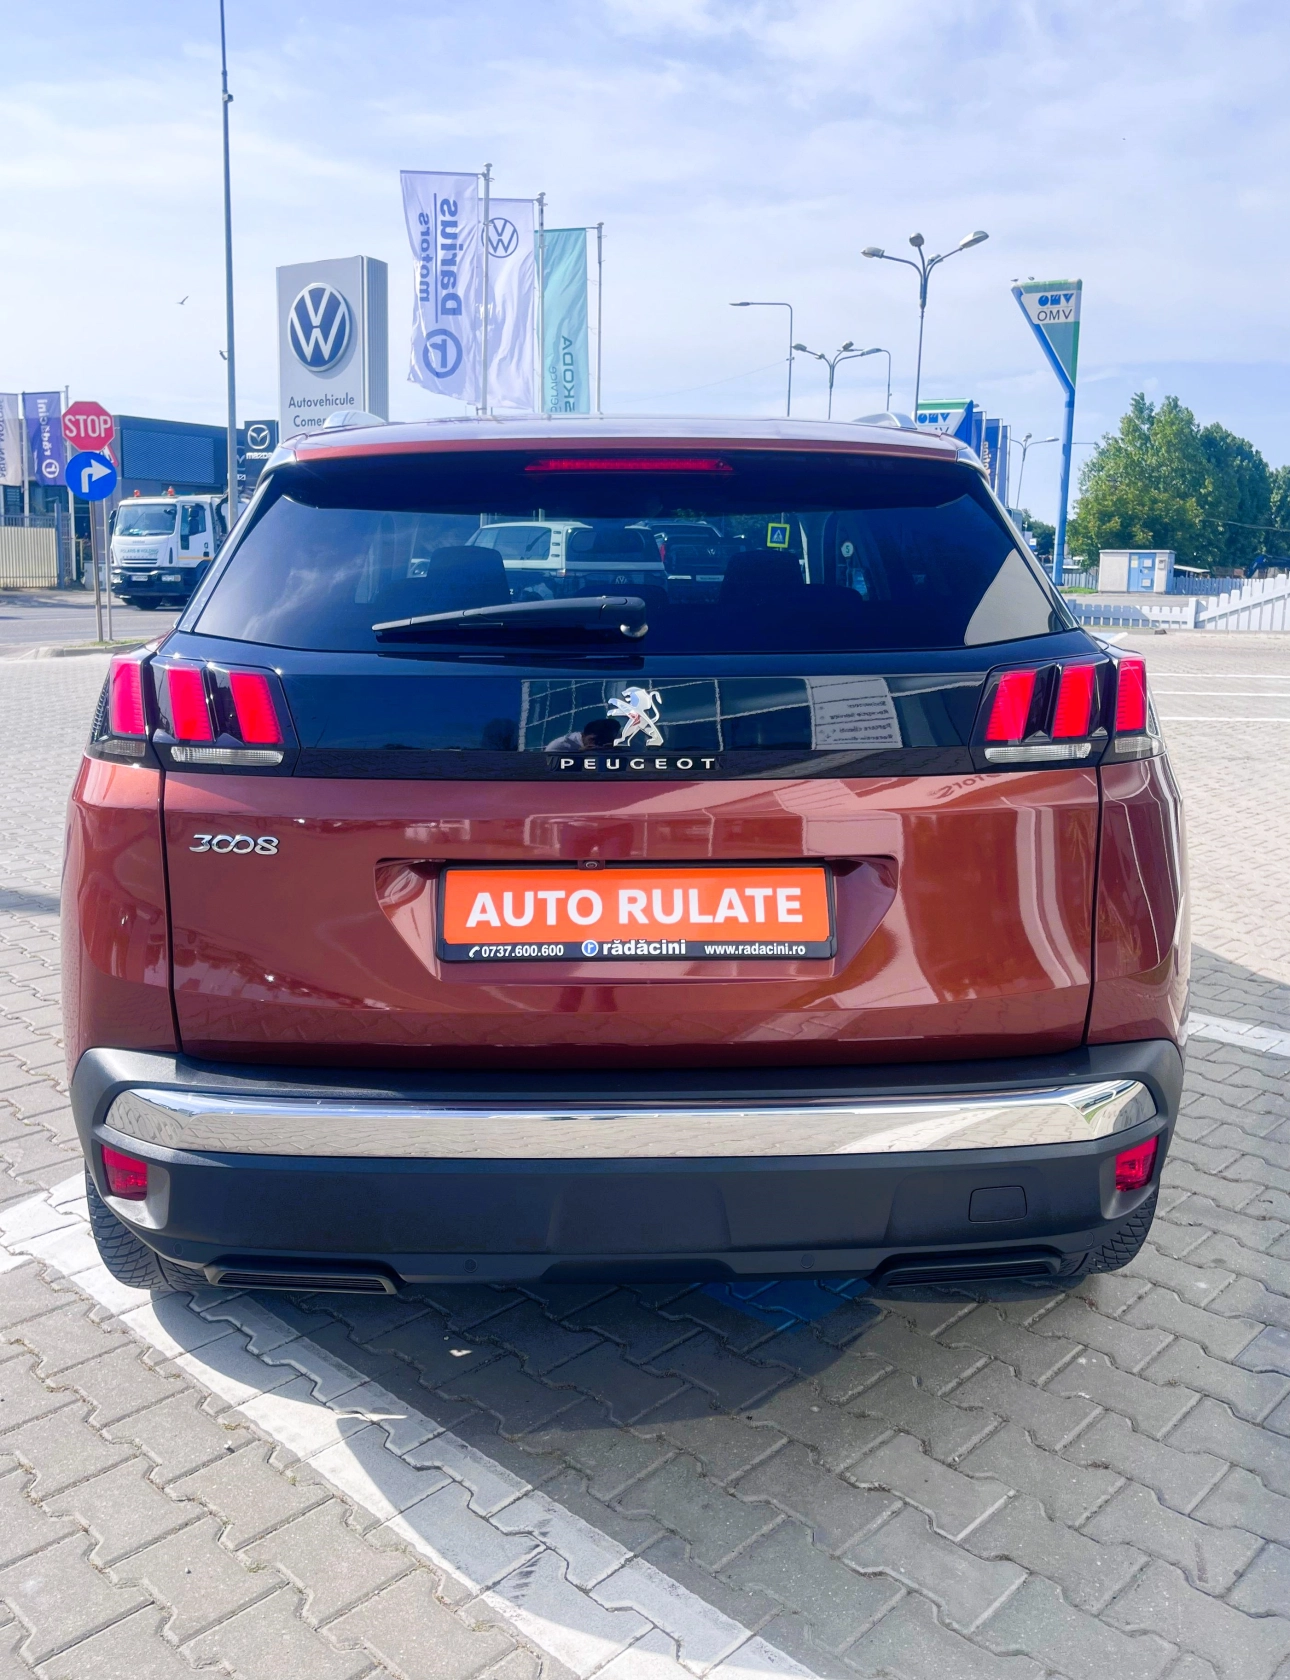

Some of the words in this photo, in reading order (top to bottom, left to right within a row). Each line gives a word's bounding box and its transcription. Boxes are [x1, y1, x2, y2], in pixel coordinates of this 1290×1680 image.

[1037, 309, 1073, 322] OMV
[288, 393, 355, 409] Autovehicule
[64, 415, 112, 438] STOP
[560, 758, 715, 770] PEUGEOT
[189, 834, 280, 856] 3008
[465, 889, 603, 928] AUTO
[618, 888, 803, 925] RULATE
[481, 944, 565, 958] 0737.600.600
[603, 939, 686, 955] rădăcini
[704, 943, 806, 955] www.radacini.ro
